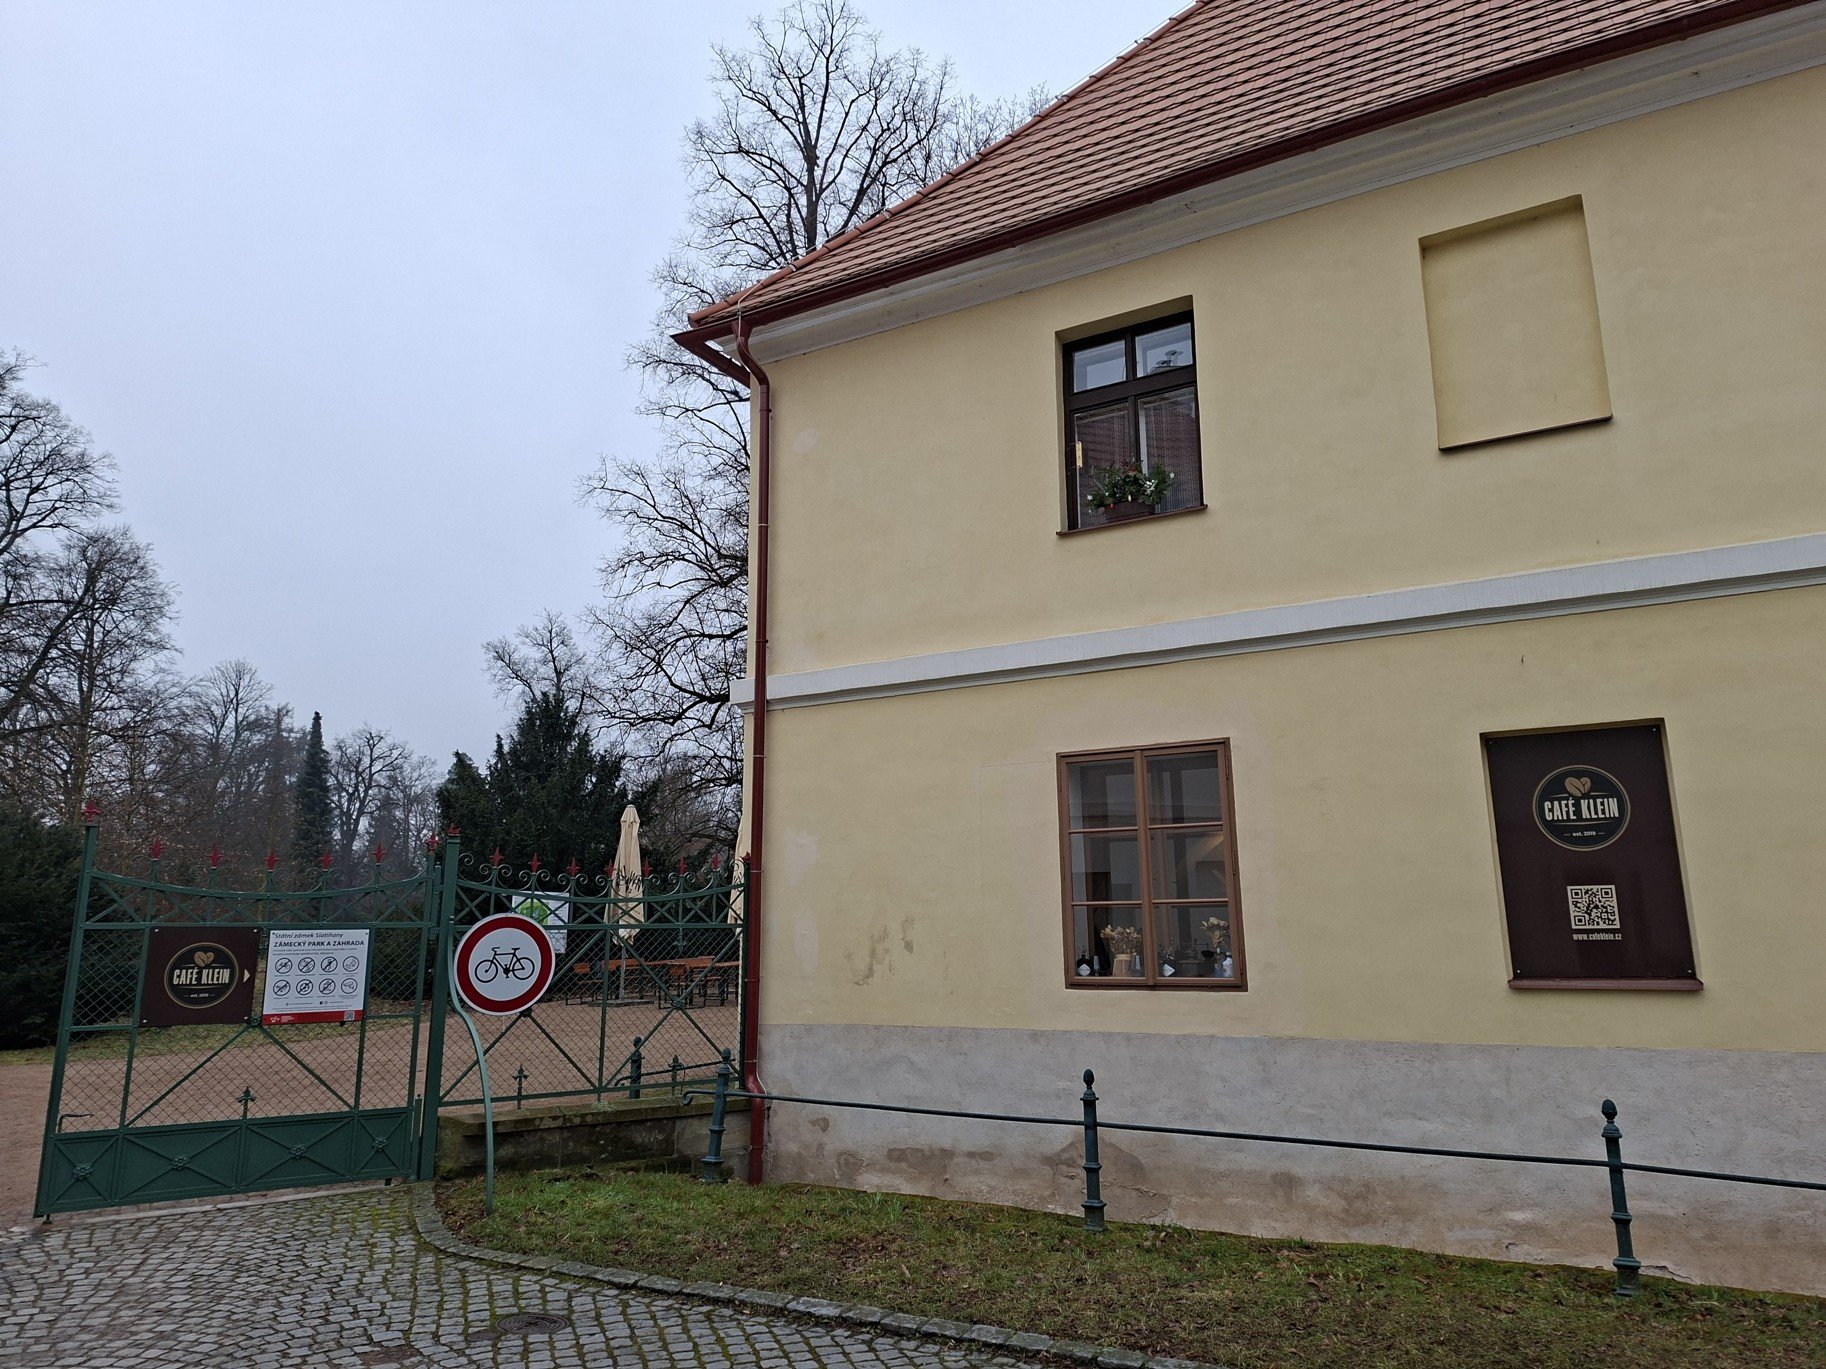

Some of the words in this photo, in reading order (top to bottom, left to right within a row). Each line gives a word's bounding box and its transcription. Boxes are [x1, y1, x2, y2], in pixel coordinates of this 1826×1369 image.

[1544, 796, 1577, 821] CAFÉ
[1580, 796, 1620, 819] KLEIN
[315, 931, 344, 939] Slatiňany
[273, 939, 306, 947] ZÁMECKÝ
[173, 966, 199, 984] CAFÉ
[201, 968, 230, 984] KLEIN
